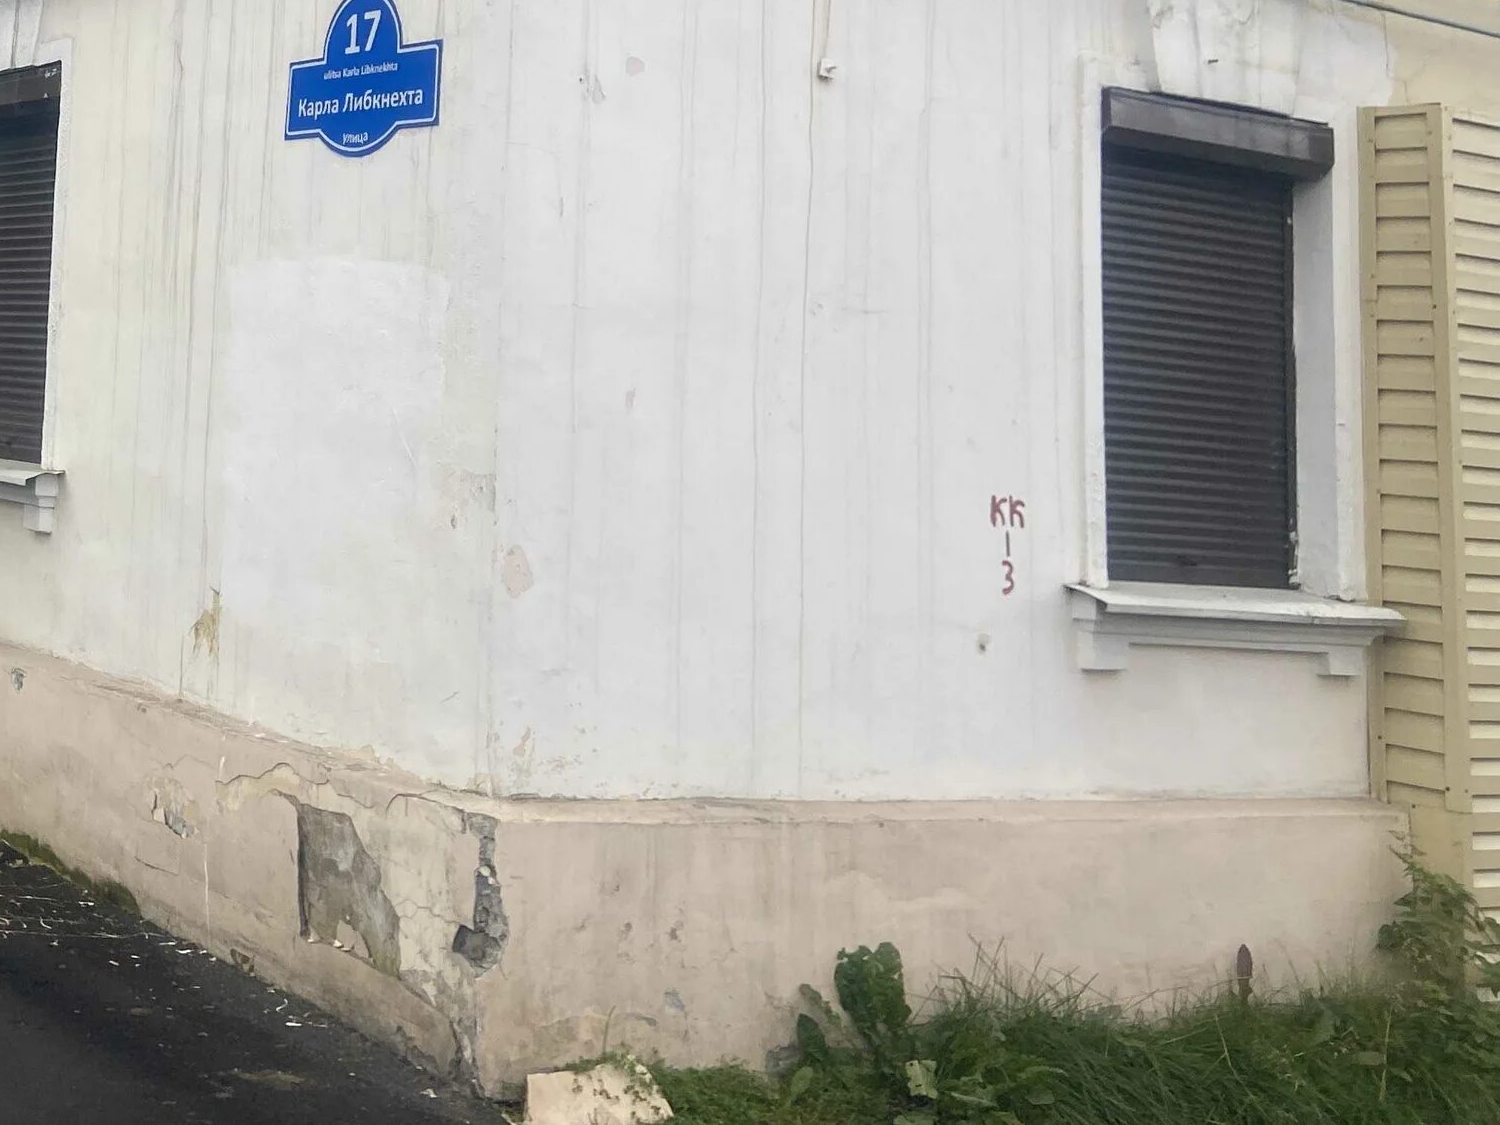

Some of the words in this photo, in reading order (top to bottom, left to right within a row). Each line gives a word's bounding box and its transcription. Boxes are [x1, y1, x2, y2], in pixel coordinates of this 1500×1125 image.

[345, 9, 382, 55] 17
[343, 67, 360, 78] Karla
[298, 98, 339, 121] Карла
[342, 88, 423, 113] Либкнехта
[342, 131, 369, 146] улица
